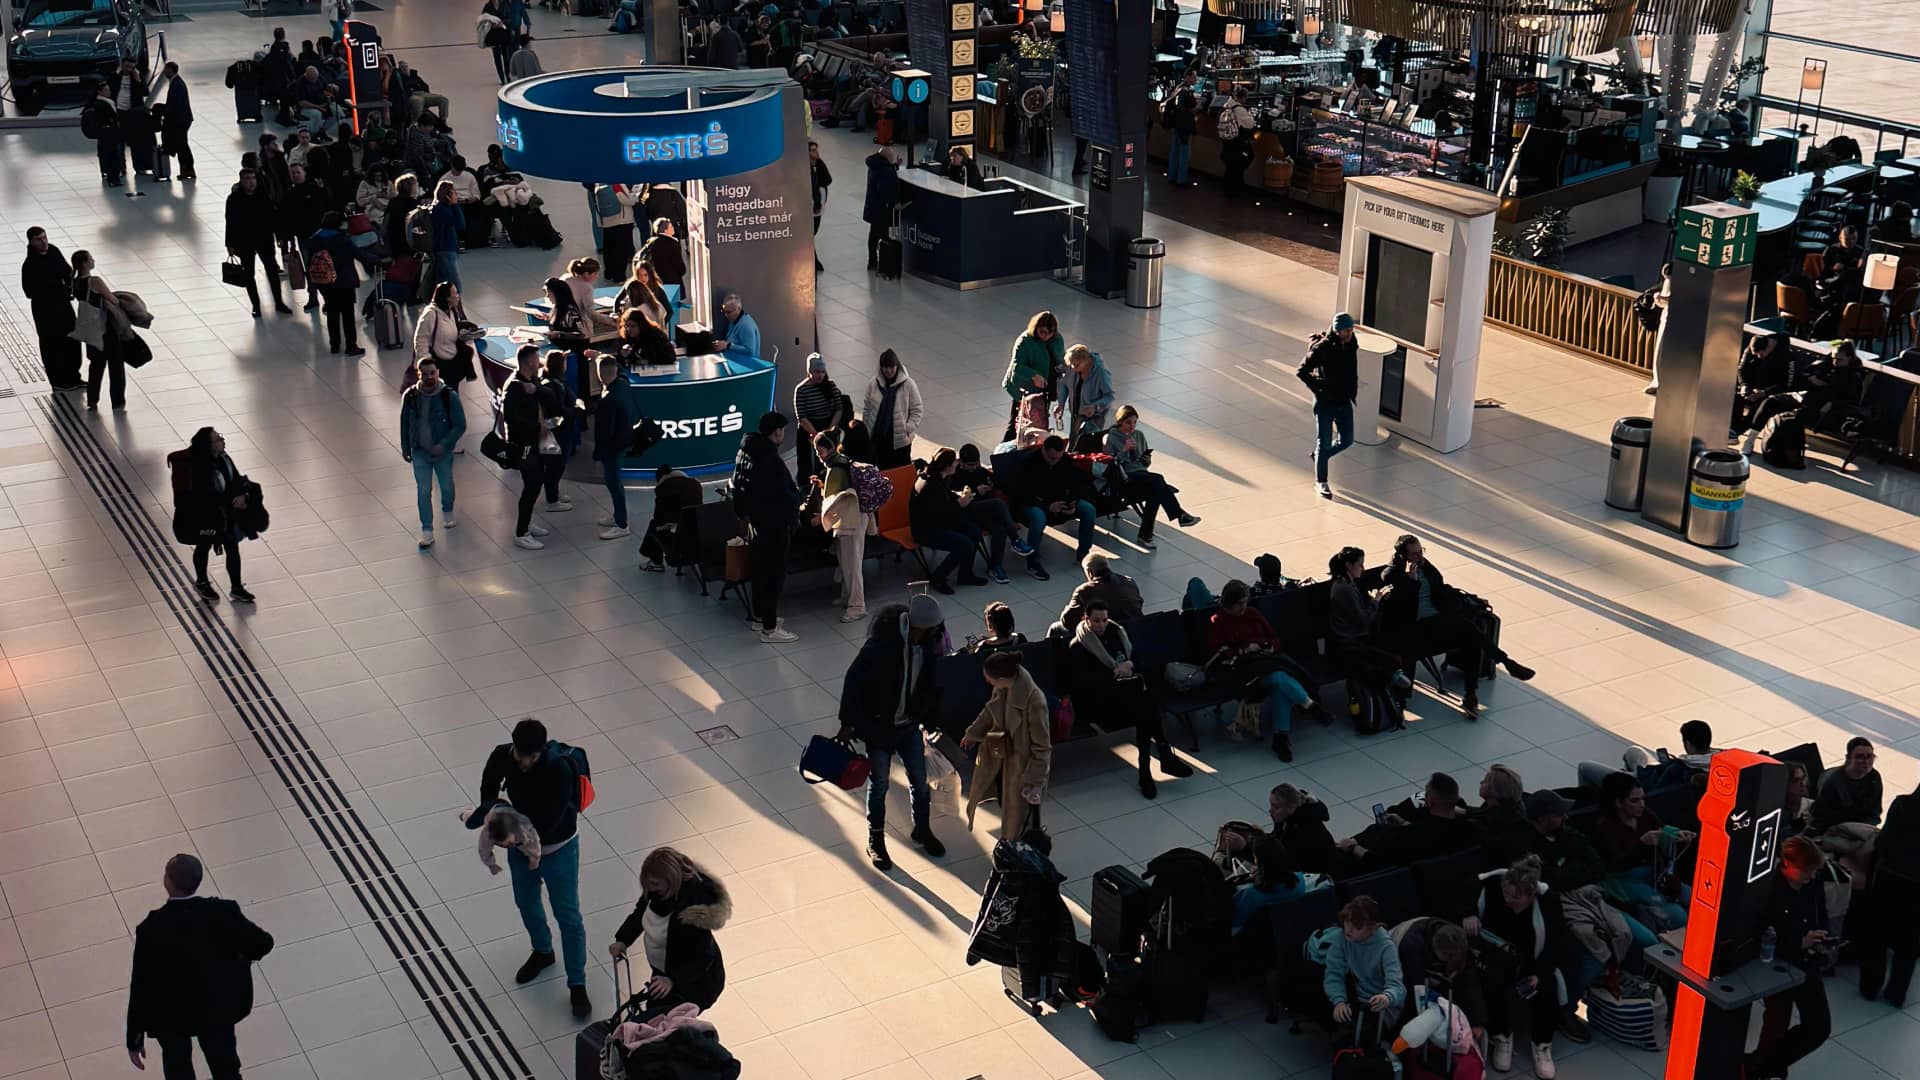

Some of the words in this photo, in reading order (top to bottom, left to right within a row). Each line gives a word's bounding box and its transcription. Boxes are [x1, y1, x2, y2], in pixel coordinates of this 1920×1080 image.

[627, 135, 704, 162] ERSTE
[715, 184, 752, 199] Higgy
[716, 196, 784, 214] magadban!
[716, 216, 733, 229] Az
[735, 214, 768, 227] Erste
[769, 210, 793, 224] már
[1364, 201, 1375, 211] PICK
[1375, 204, 1383, 213] UP
[1384, 206, 1396, 218] YOUR
[1396, 210, 1407, 222] GIFT
[1407, 213, 1430, 229] THERMOS
[1431, 221, 1445, 233] HERE
[717, 231, 743, 245] hisz
[744, 226, 793, 242] benned.
